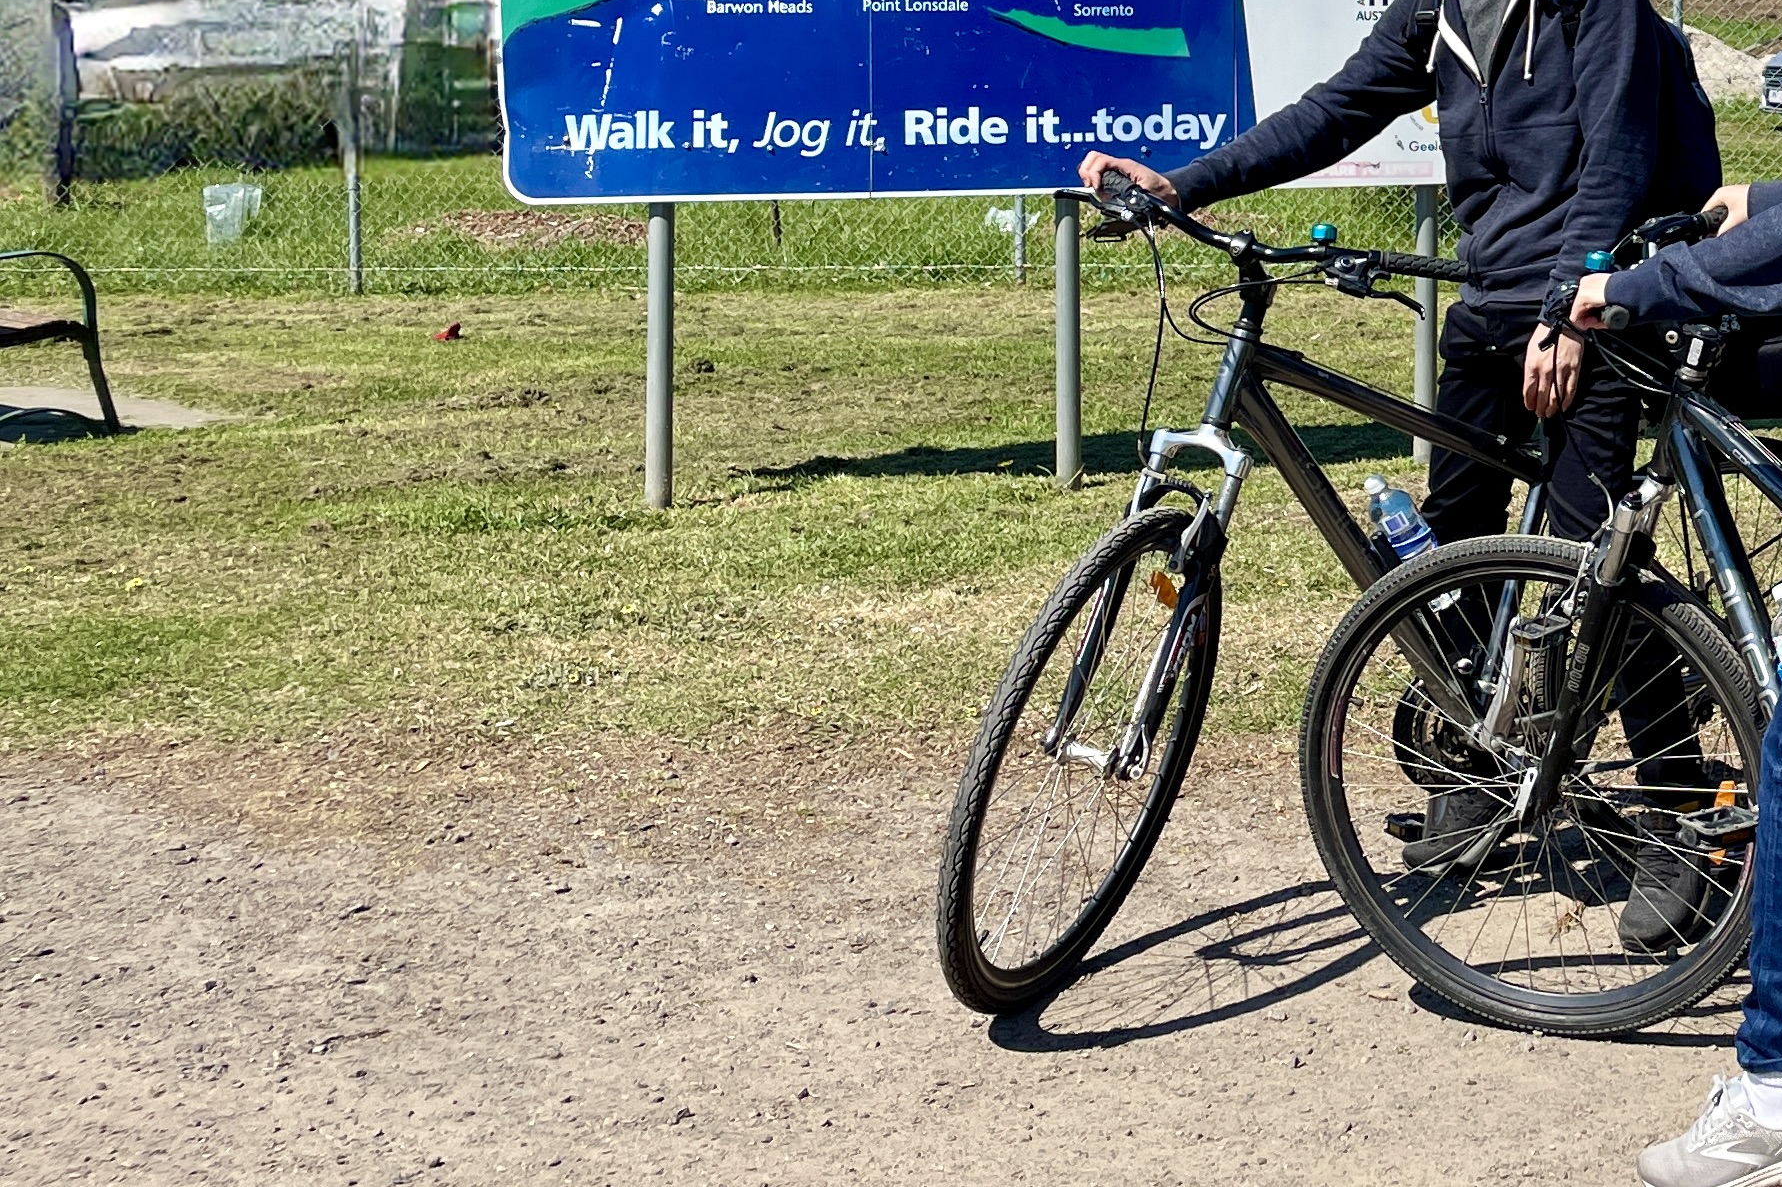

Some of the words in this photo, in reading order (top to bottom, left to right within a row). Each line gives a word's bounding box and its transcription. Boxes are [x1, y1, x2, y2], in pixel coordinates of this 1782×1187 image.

[706, 0, 763, 14] Barwon
[768, 0, 814, 14] Heads
[1073, 3, 1134, 18] Sorrento
[565, 110, 675, 151] Walk
[692, 109, 740, 154] it,
[753, 110, 831, 158] Jog
[904, 106, 1009, 147] Ride
[1026, 103, 1228, 150] it...today
